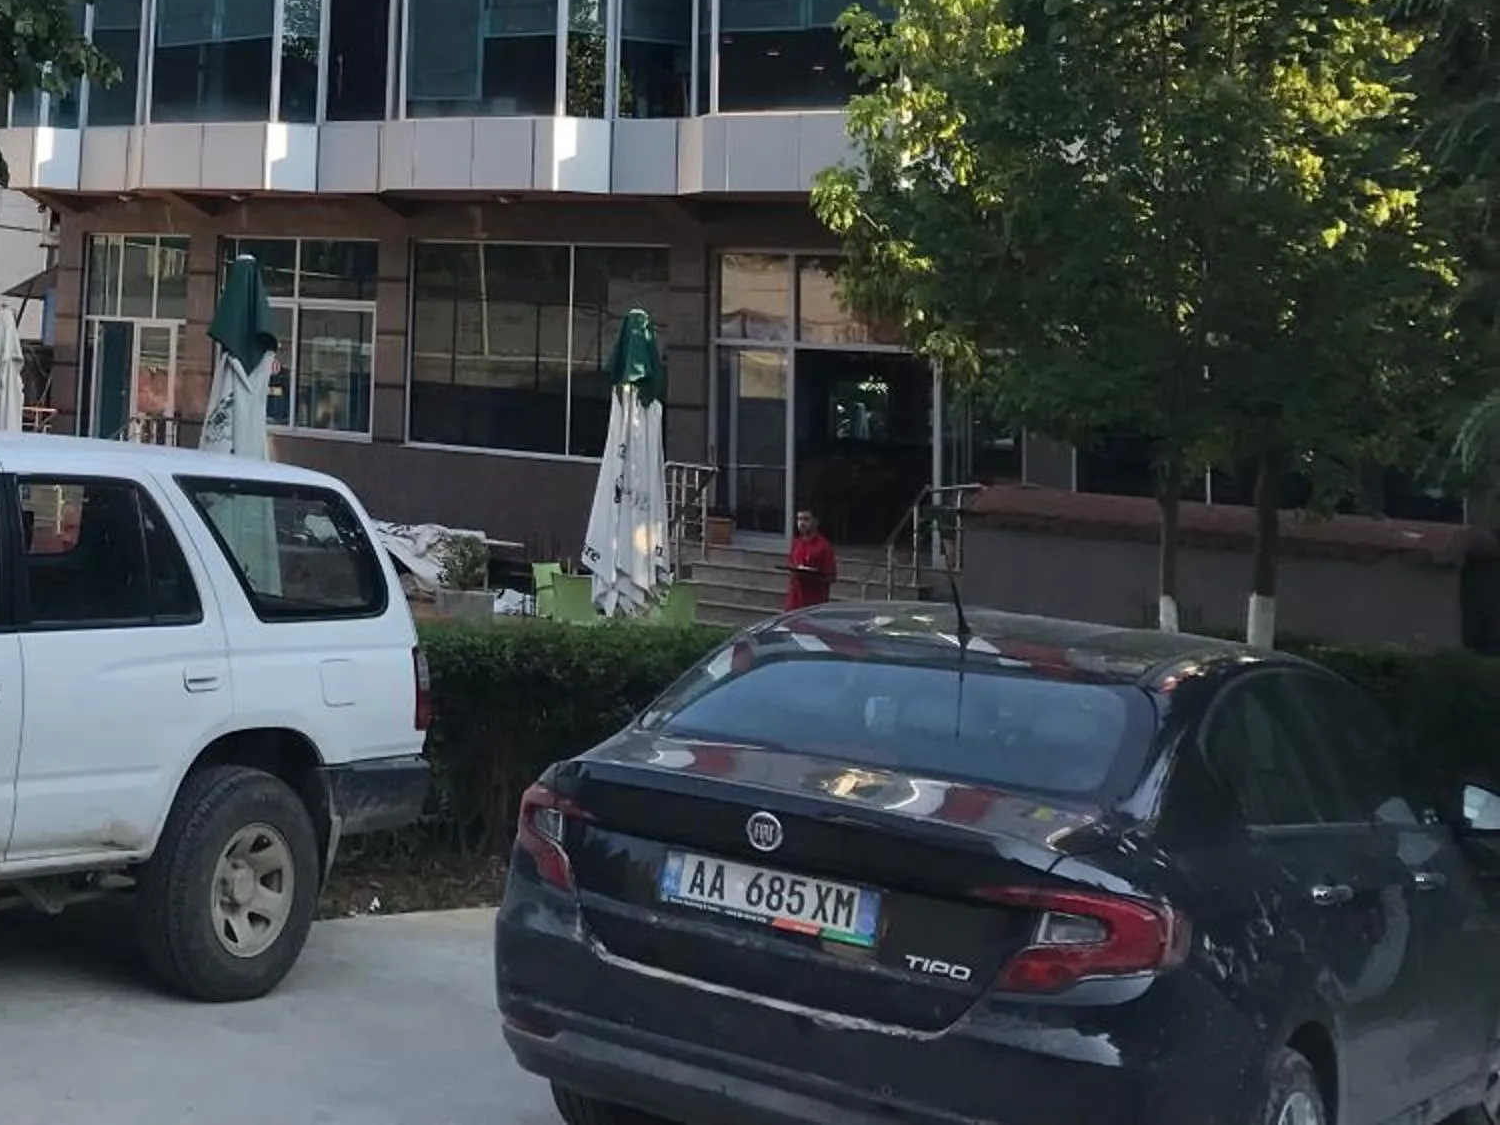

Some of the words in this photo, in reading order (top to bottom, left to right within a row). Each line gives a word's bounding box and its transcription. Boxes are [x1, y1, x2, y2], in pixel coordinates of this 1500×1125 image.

[687, 860, 726, 900] AA
[745, 872, 806, 916] 685
[811, 882, 856, 927] XM
[904, 954, 972, 981] TIPO
